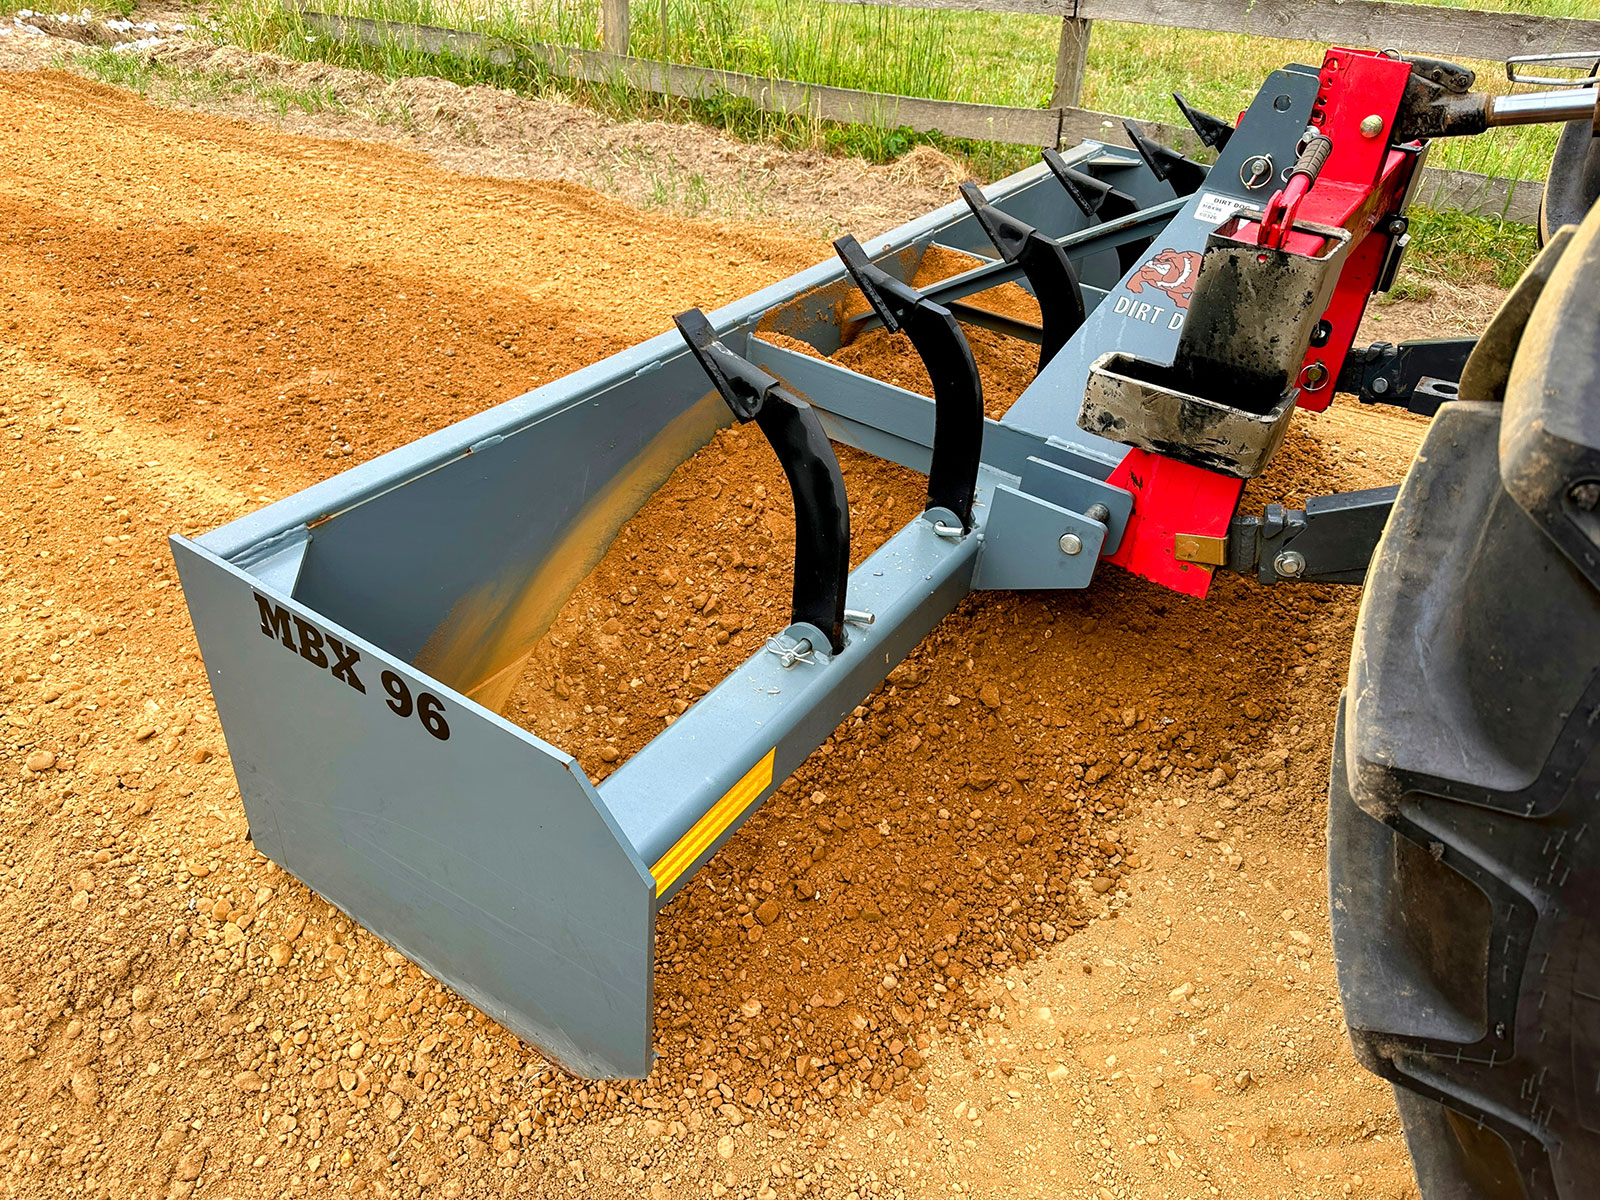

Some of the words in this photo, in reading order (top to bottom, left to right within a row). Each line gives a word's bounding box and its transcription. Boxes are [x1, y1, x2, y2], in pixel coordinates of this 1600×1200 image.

[1213, 198, 1232, 206] DIRT
[1113, 296, 1165, 324] DIRT
[1167, 312, 1185, 330] D
[253, 591, 366, 695] MBX
[381, 670, 450, 741] 96
